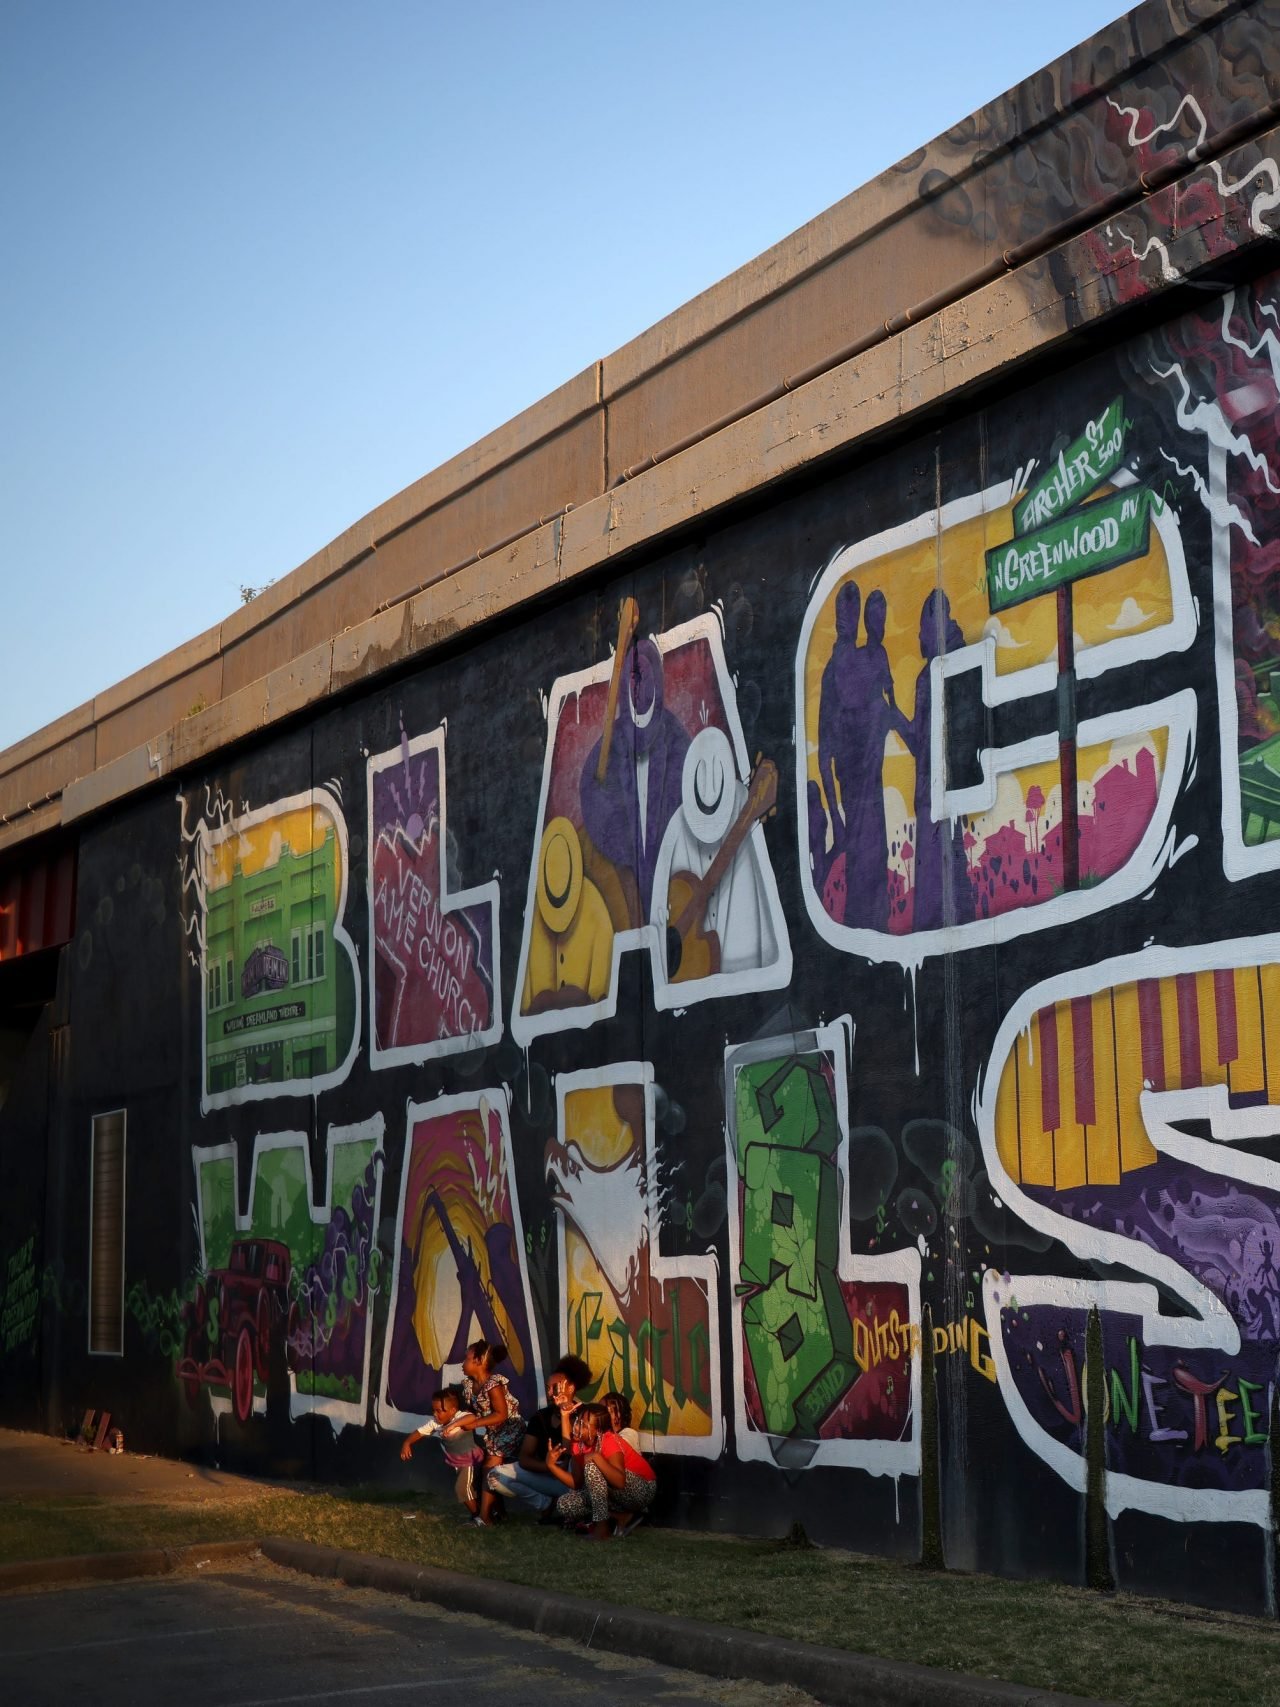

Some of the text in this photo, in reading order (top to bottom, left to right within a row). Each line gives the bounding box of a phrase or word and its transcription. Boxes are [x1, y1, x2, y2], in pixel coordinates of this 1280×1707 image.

[1086, 407, 1110, 451] ST
[1022, 428, 1122, 531] ARCHER 500
[1004, 517, 1120, 591] GREENWOOD
[1120, 493, 1140, 523] AV
[375, 876, 484, 1048] AME CHURCH
[397, 858, 471, 980] VERNON
[245, 1009, 278, 1027] DREAMLAND
[192, 1014, 924, 1480] WALL
[804, 1363, 846, 1417] BAND
[852, 1308, 998, 1385] OUTSTADING
